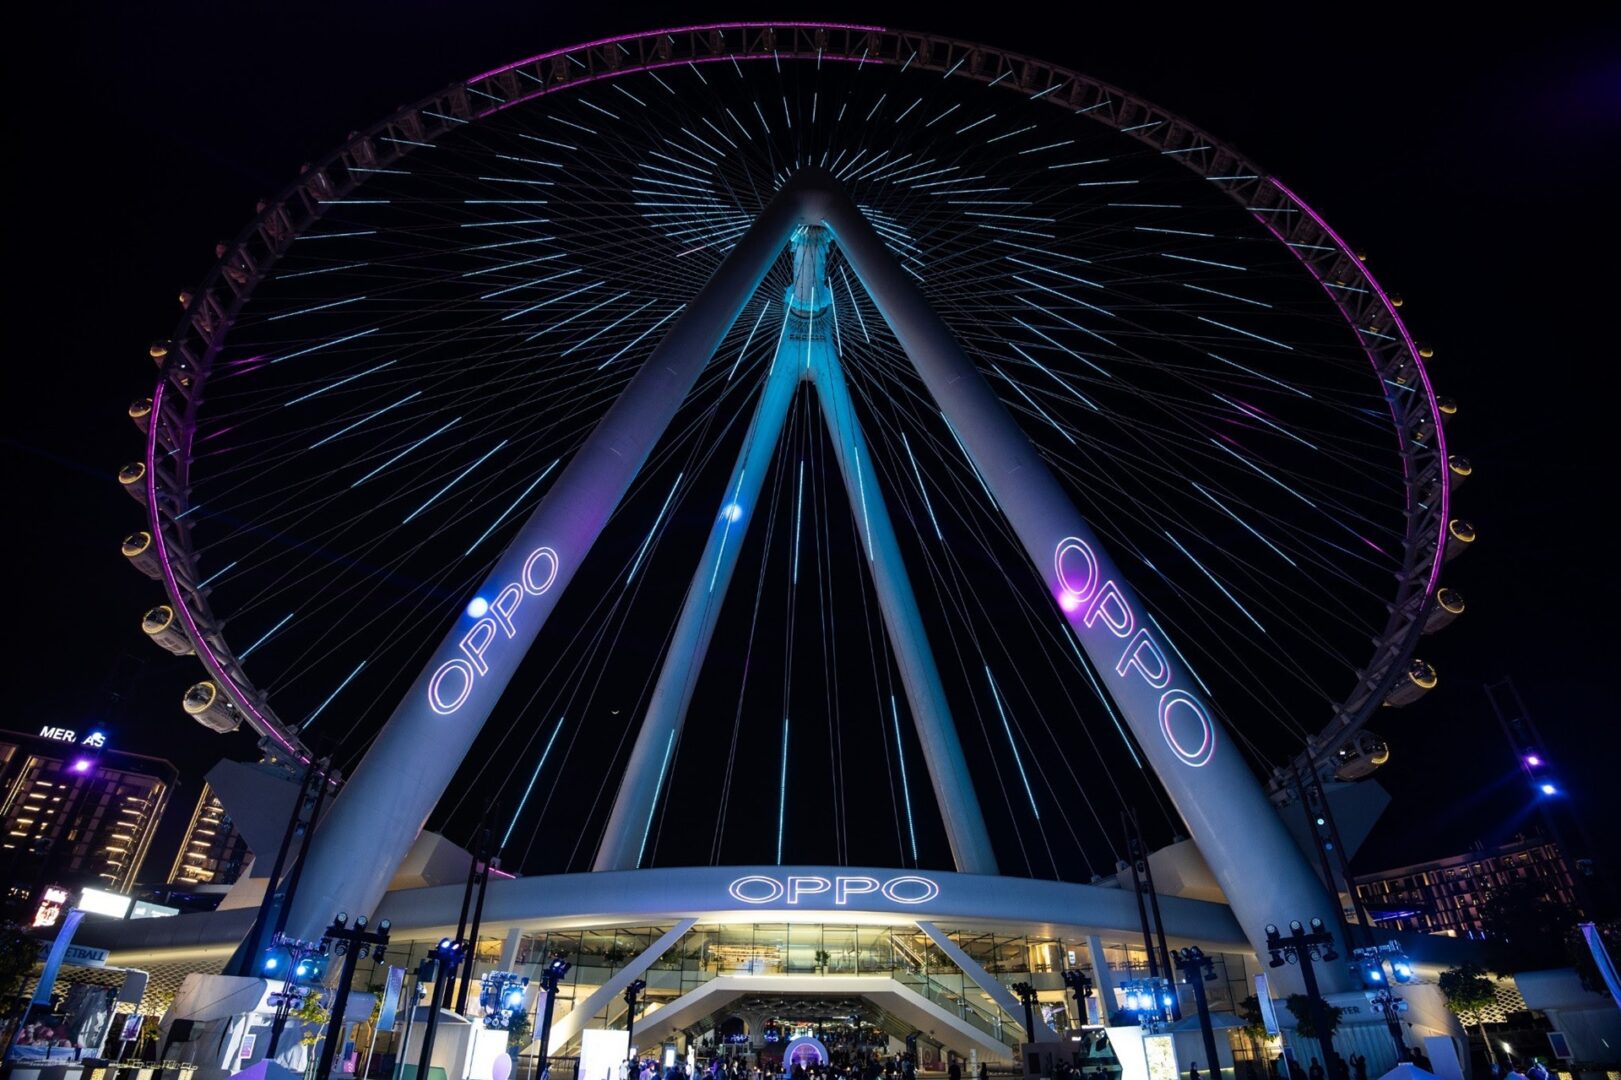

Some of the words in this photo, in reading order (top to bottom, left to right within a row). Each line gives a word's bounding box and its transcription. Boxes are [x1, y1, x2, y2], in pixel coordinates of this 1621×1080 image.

[427, 546, 559, 715] OPPO
[1054, 536, 1215, 767] OPPO
[39, 725, 106, 747] MERAS
[728, 875, 940, 905] OPPO
